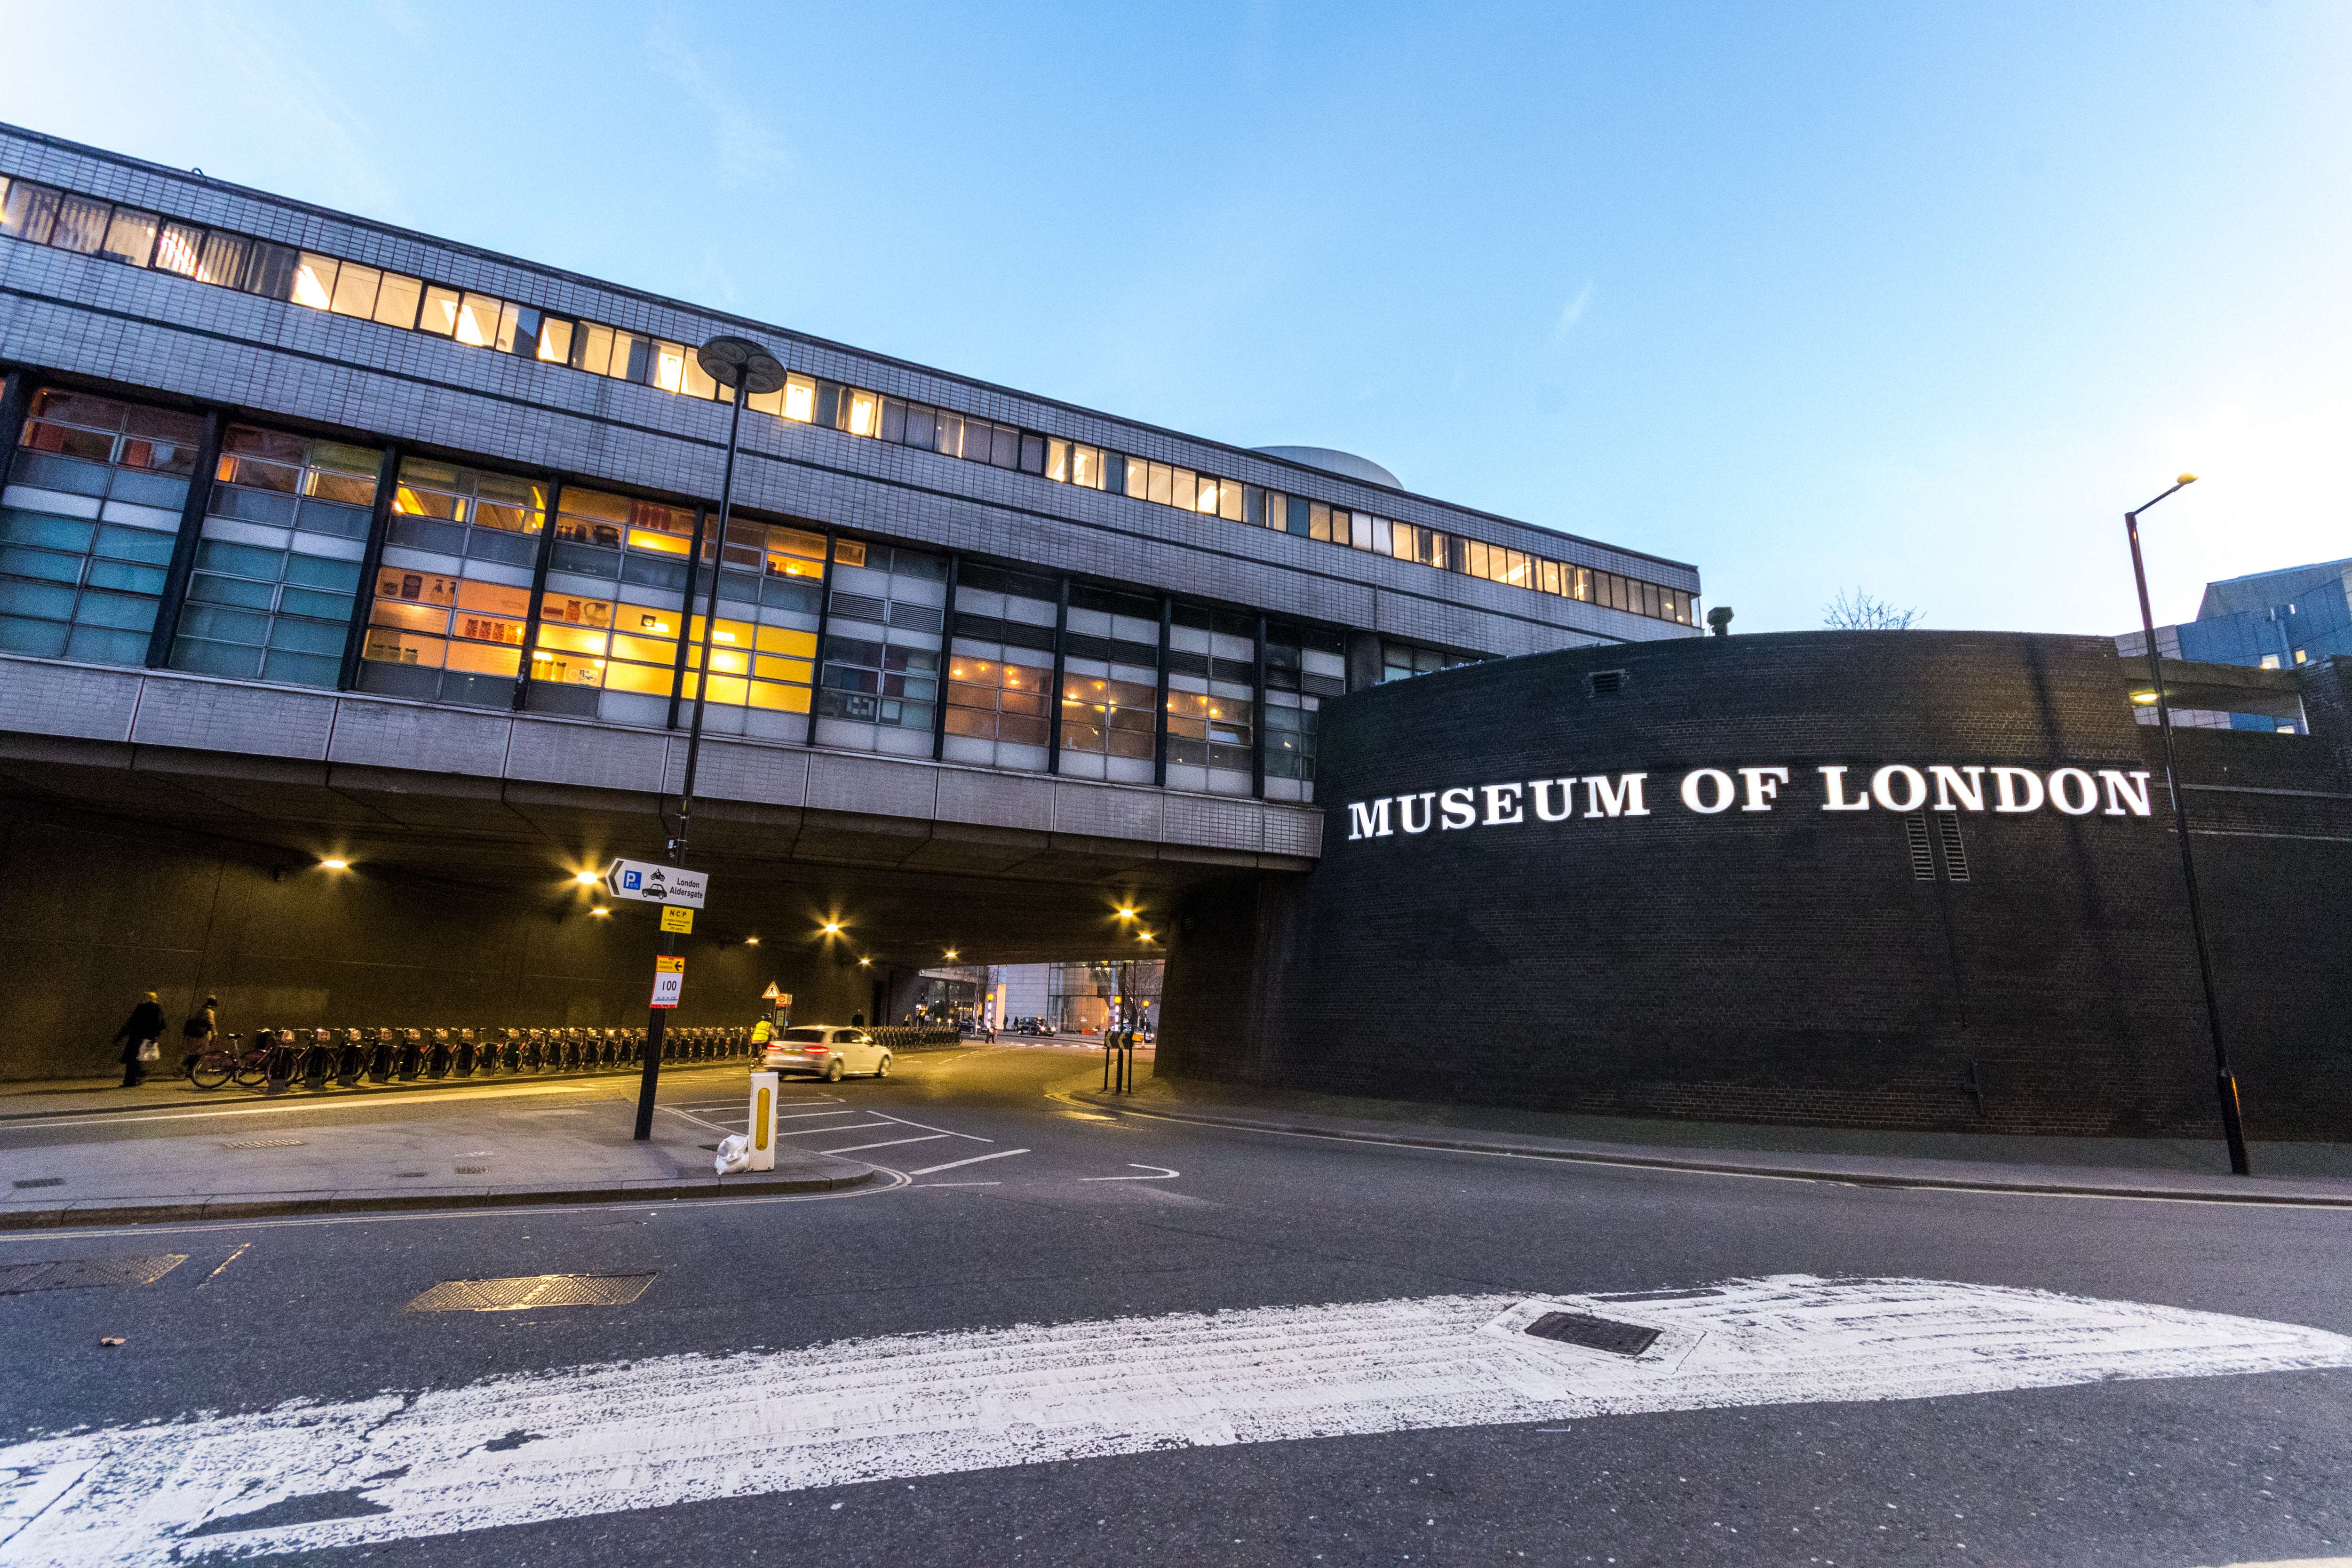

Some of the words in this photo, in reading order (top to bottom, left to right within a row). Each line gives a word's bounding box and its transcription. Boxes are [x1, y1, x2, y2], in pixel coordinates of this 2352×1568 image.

[1348, 773, 1650, 840] MUSEUM
[1681, 767, 1788, 814] OF
[1818, 764, 2151, 816] LONDON
[677, 877, 699, 888] London
[669, 886, 703, 899] Aldersgate
[662, 980, 676, 991] 100
